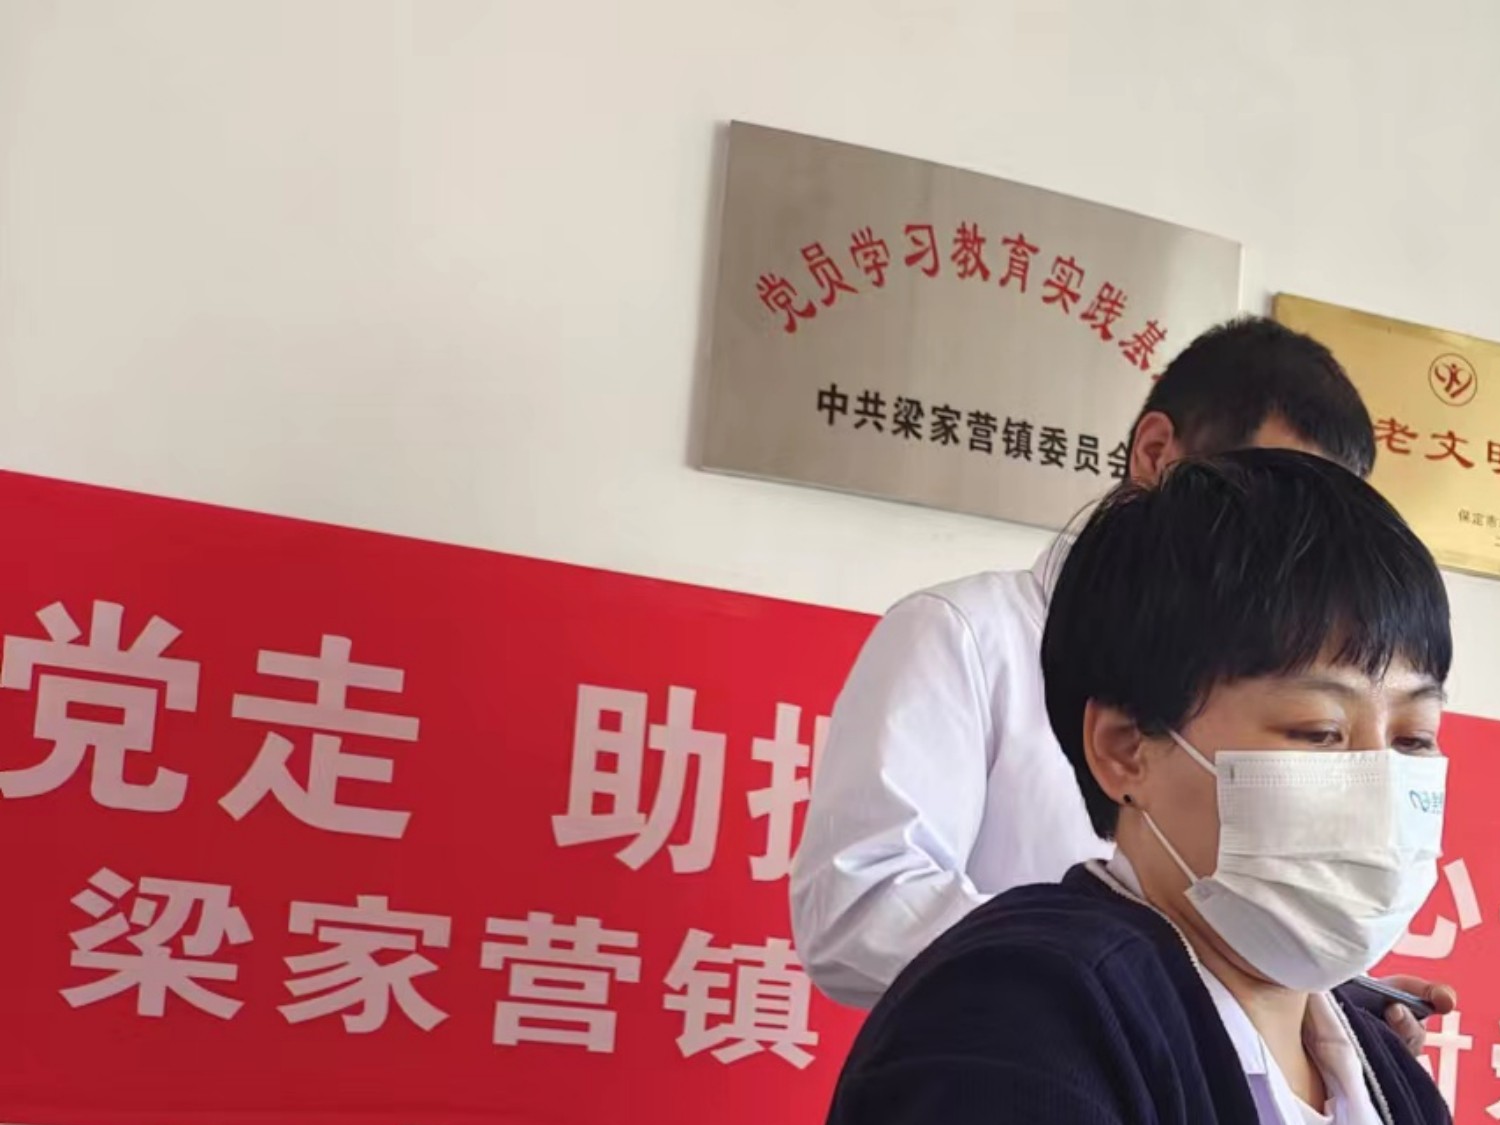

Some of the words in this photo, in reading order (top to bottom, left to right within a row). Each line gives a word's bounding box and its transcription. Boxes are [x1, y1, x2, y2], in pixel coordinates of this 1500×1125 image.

[756, 221, 1168, 381] 党员学习教育实践基
[816, 383, 1128, 480] 中共梁家营镇委员会
[0, 599, 420, 839] 党走
[58, 866, 820, 1071] 梁家营镇
